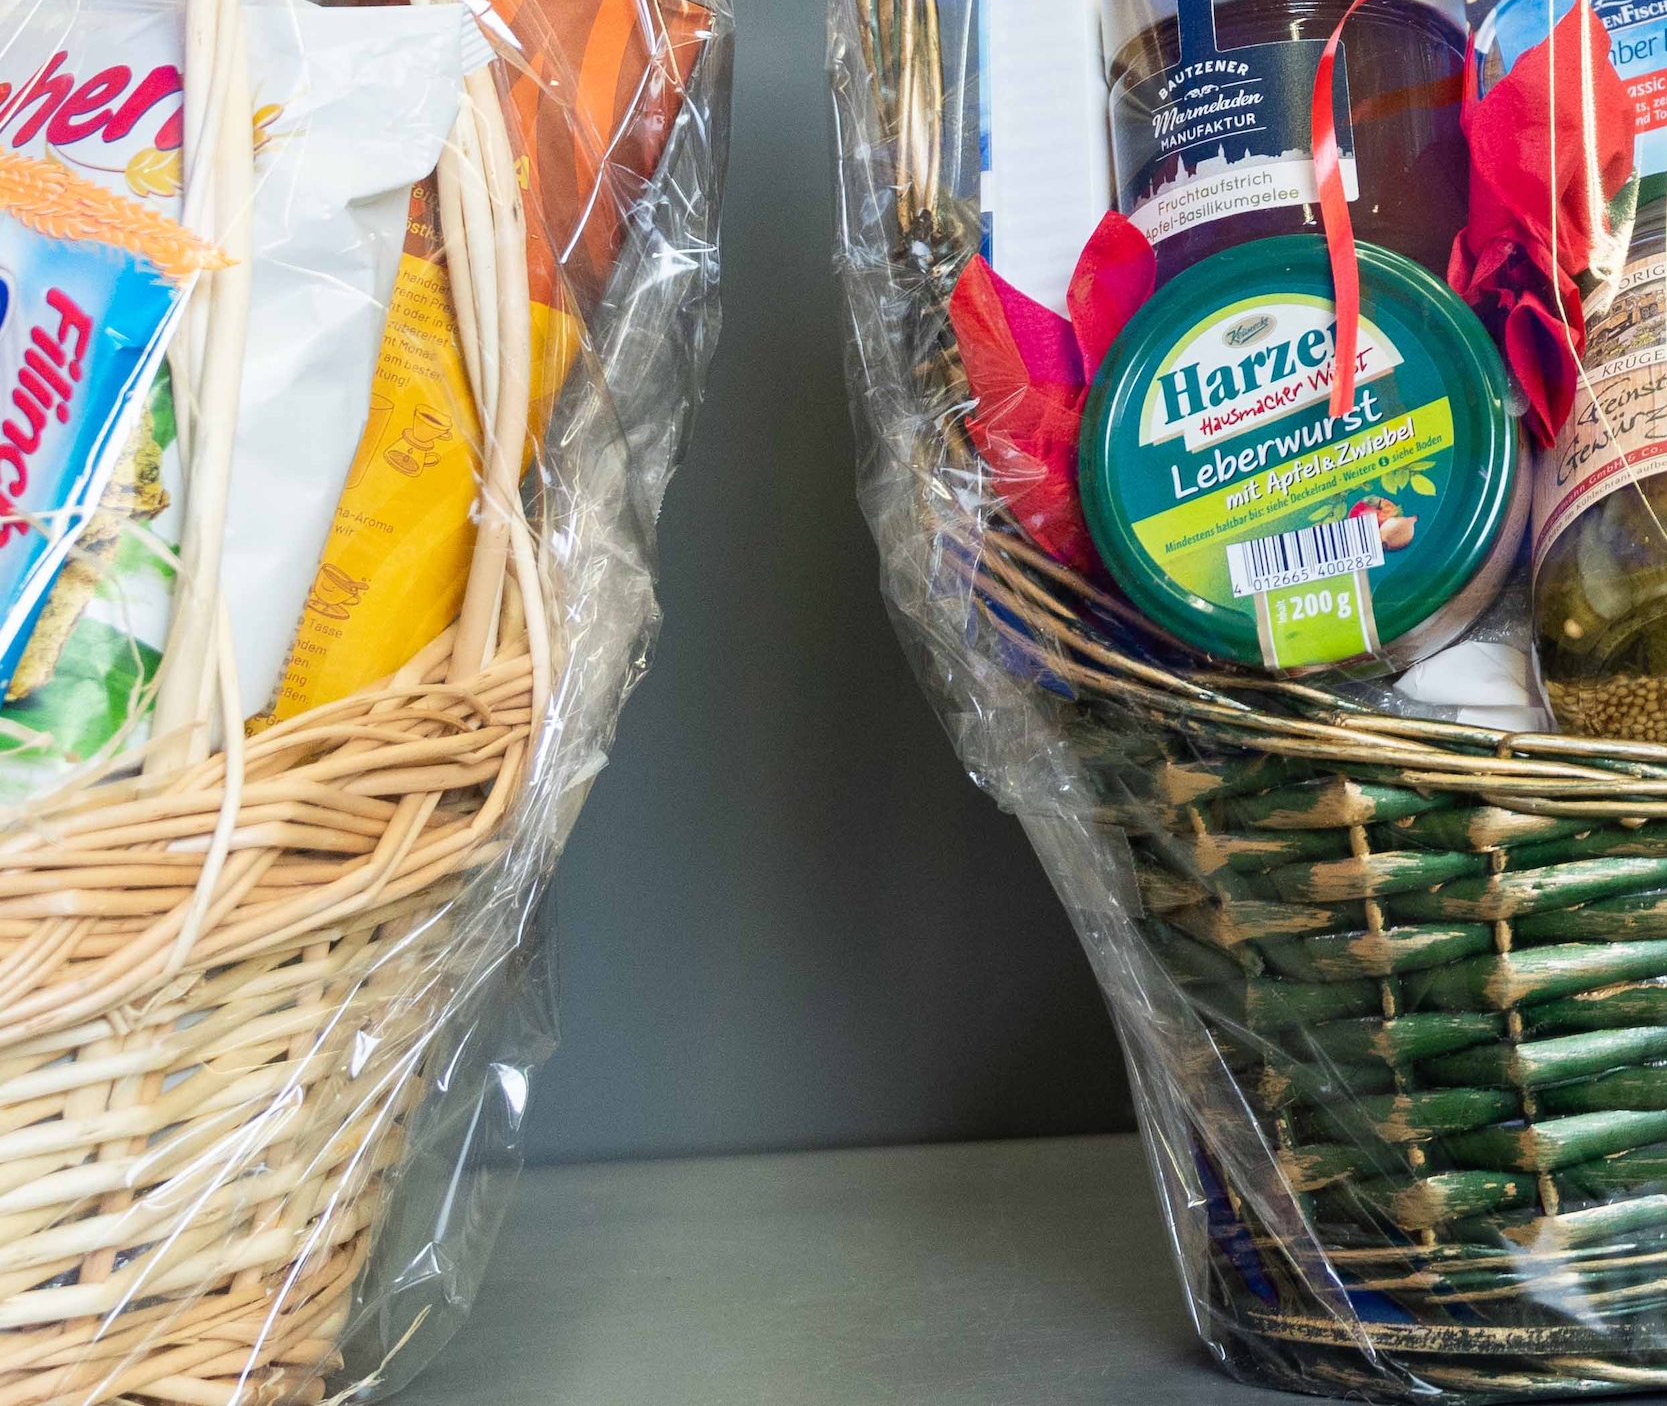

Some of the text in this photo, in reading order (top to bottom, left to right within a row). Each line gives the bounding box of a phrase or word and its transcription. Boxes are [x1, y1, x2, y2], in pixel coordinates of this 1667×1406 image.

[1158, 59, 1251, 101] BAUTZENER
[1152, 88, 1264, 139] Marmeladen
[1160, 112, 1257, 152] MANUFAKTUR
[1145, 186, 1300, 241] Apfel-Basilikumgelee
[1157, 171, 1273, 216] Fruchtaufstrich
[1171, 389, 1383, 499] Leberwurst
[1226, 485, 1263, 511] mit
[1267, 454, 1320, 497] Apfel
[1335, 416, 1416, 467] Zwiebel
[1641, 445, 1664, 457] Co.
[1165, 527, 1216, 554] Mindestens
[1216, 513, 1248, 534] haltbar
[1266, 498, 1289, 514] siehe
[1290, 475, 1339, 504] Deckelrand
[1342, 462, 1377, 482] Weitere
[1392, 445, 1415, 463] siehe
[1416, 432, 1443, 452] Boden
[1233, 554, 1373, 595] 4 012665 400282
[1289, 589, 1333, 621] 200
[1337, 591, 1352, 619] g
[309, 618, 343, 639] Tasse
